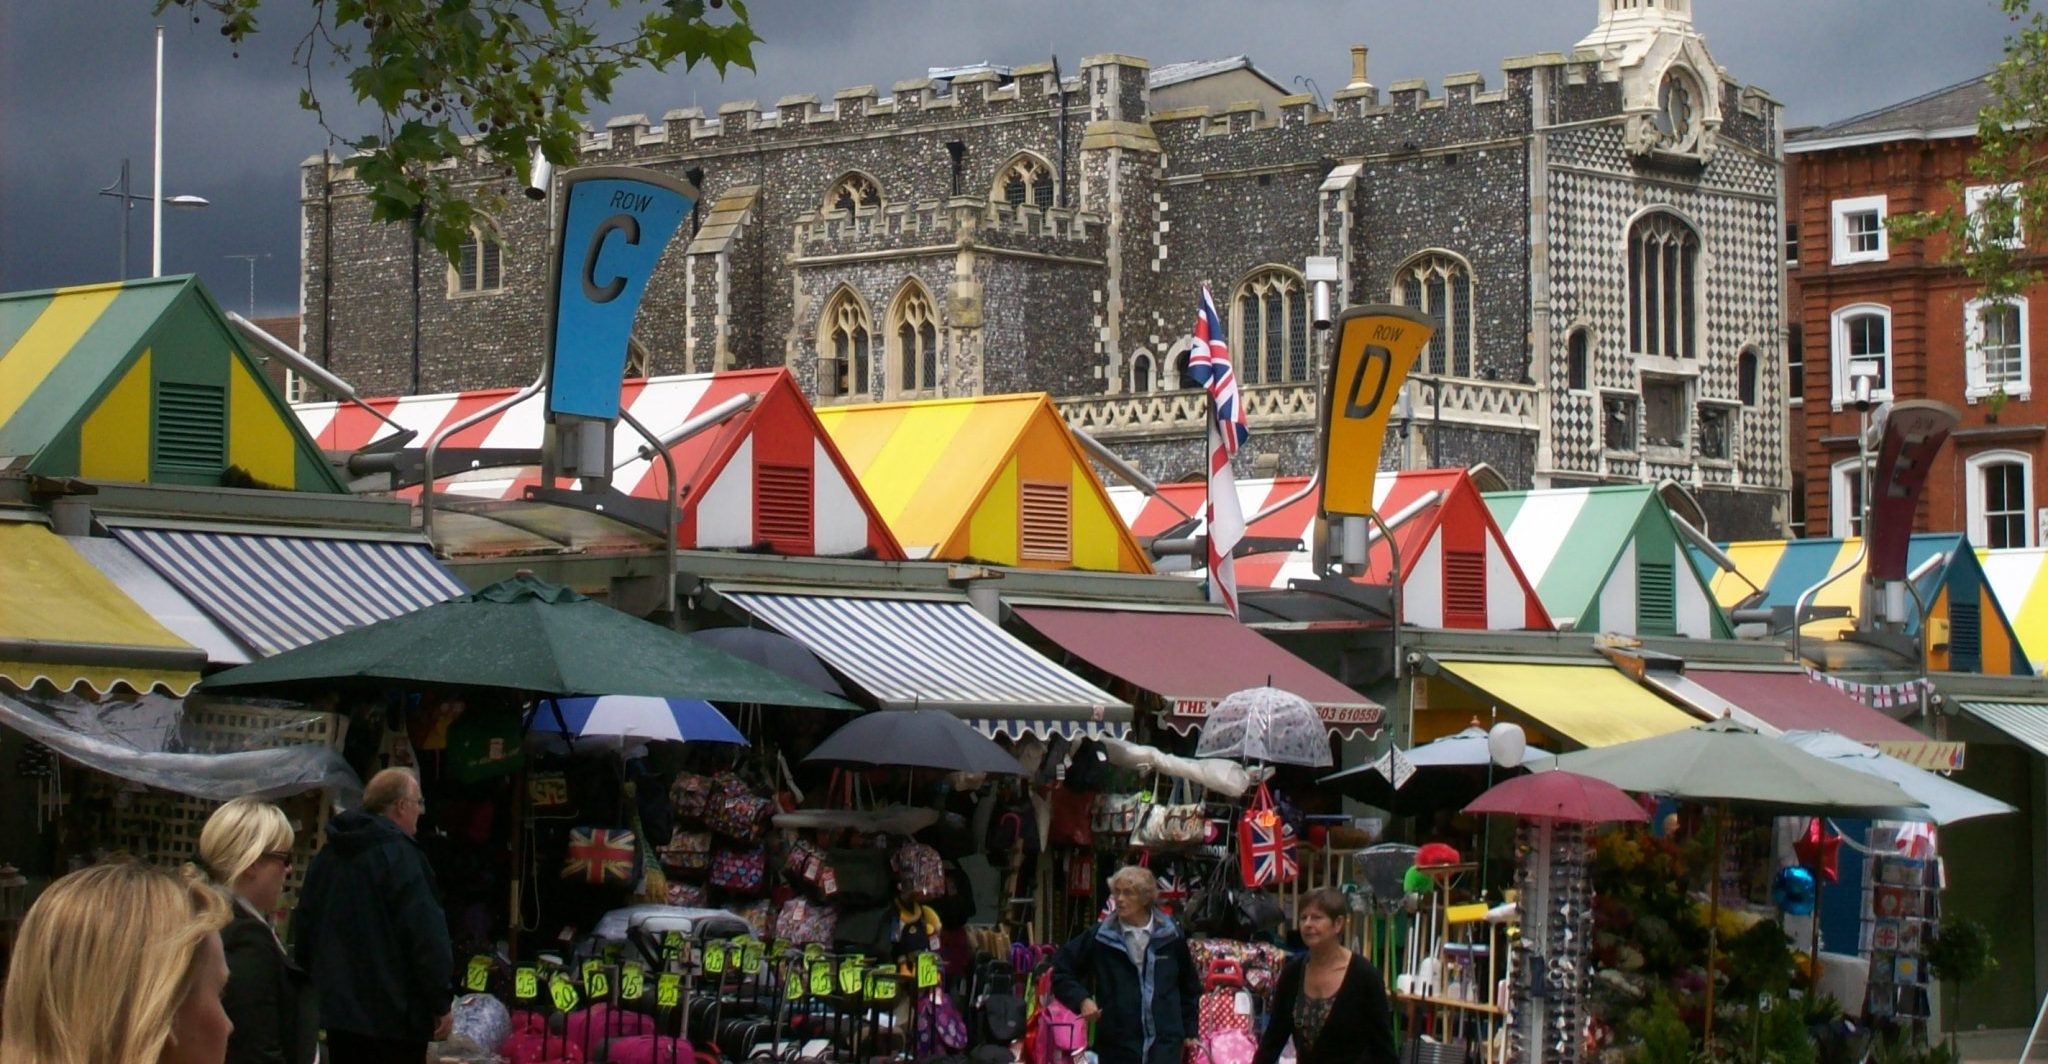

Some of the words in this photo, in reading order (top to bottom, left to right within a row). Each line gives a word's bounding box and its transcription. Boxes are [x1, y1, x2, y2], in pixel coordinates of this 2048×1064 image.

[610, 190, 654, 213] ROW
[581, 213, 641, 304] C
[1372, 324, 1405, 342] ROW
[1343, 343, 1393, 420] D
[1886, 432, 1930, 498] E
[1176, 700, 1207, 715] THE
[1338, 708, 1380, 722] 610558
